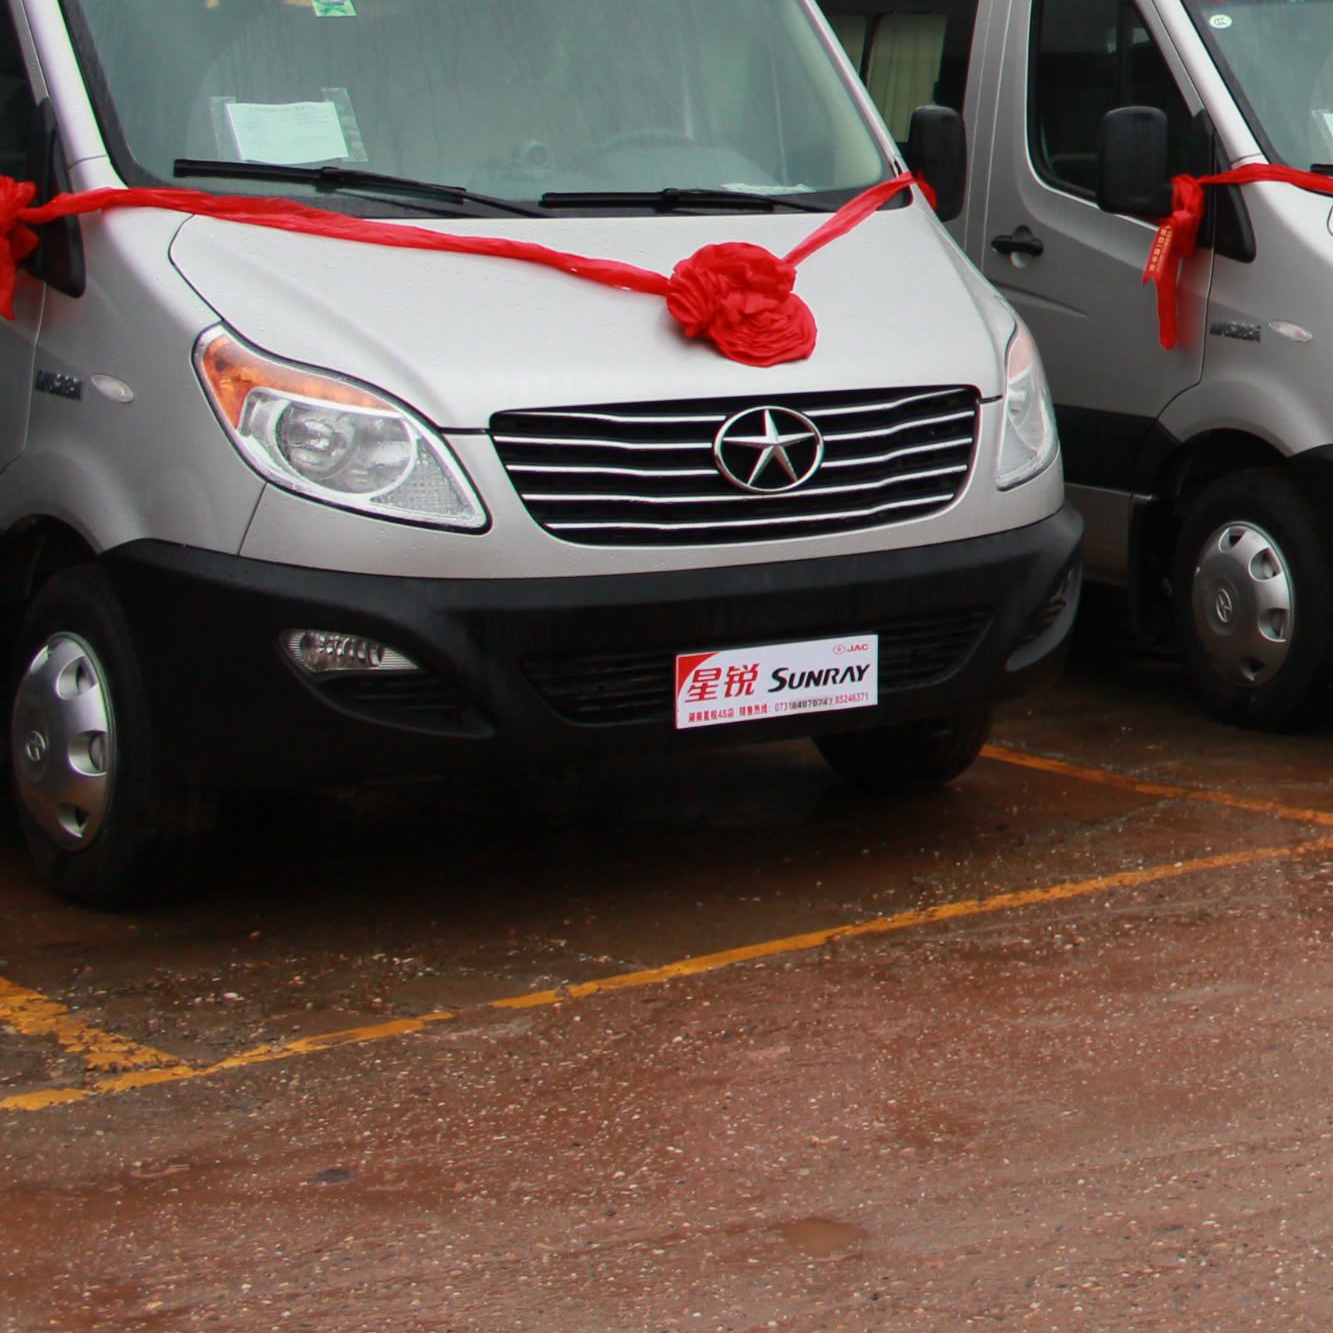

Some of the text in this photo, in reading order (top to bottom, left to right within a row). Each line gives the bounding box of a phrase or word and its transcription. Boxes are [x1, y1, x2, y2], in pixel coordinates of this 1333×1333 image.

[847, 643, 869, 653] JAC
[684, 663, 871, 703] 星锐 SUNRAY
